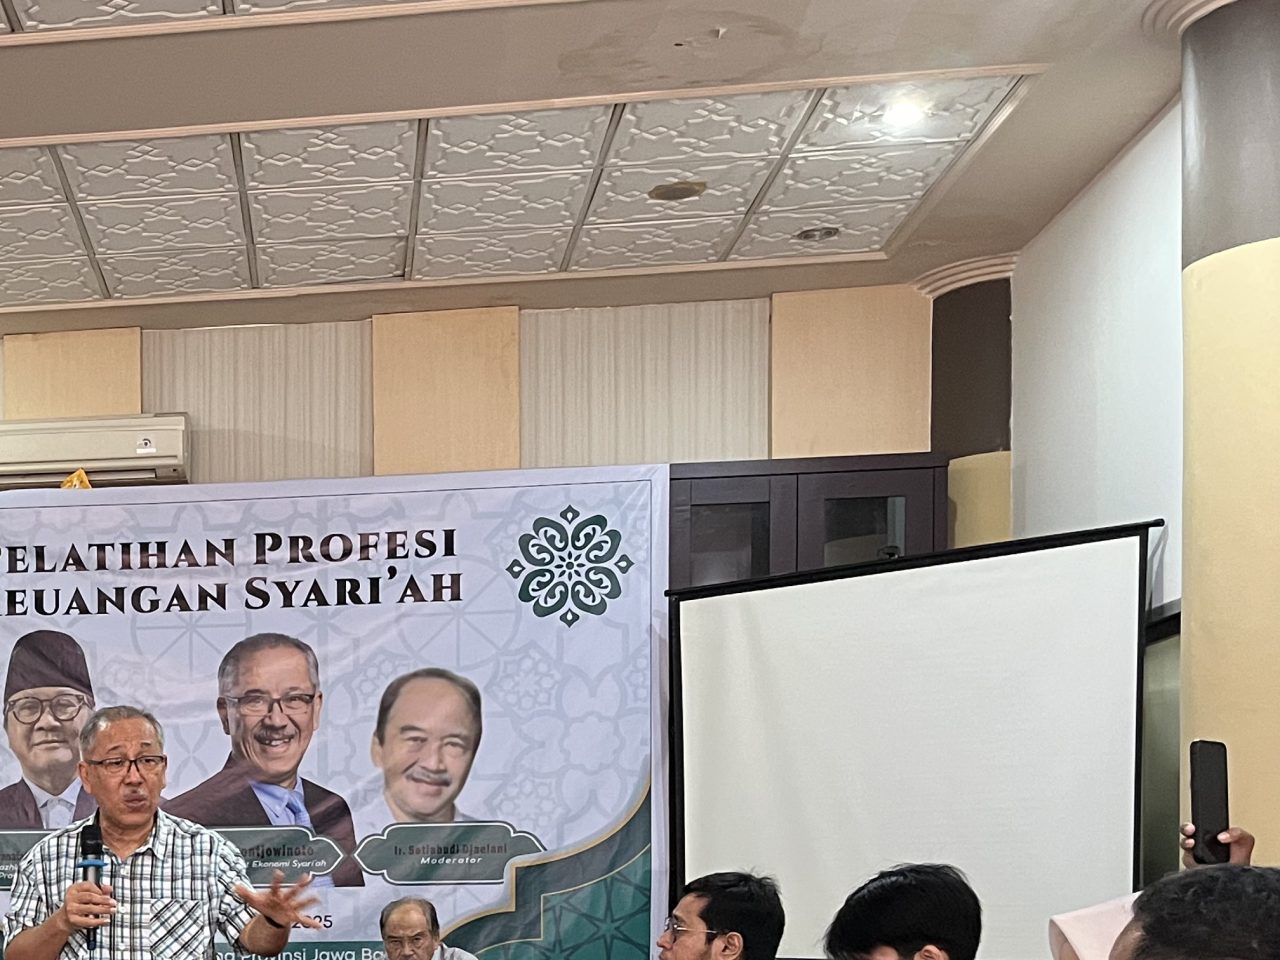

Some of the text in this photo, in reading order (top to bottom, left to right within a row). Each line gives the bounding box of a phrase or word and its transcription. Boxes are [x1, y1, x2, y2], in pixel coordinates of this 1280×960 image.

[254, 528, 457, 566] PROFESI
[244, 565, 463, 610] SYARI'AH
[240, 844, 314, 858] ontjowinoto
[252, 860, 291, 868] Ekonomi
[420, 856, 483, 865] Moderator
